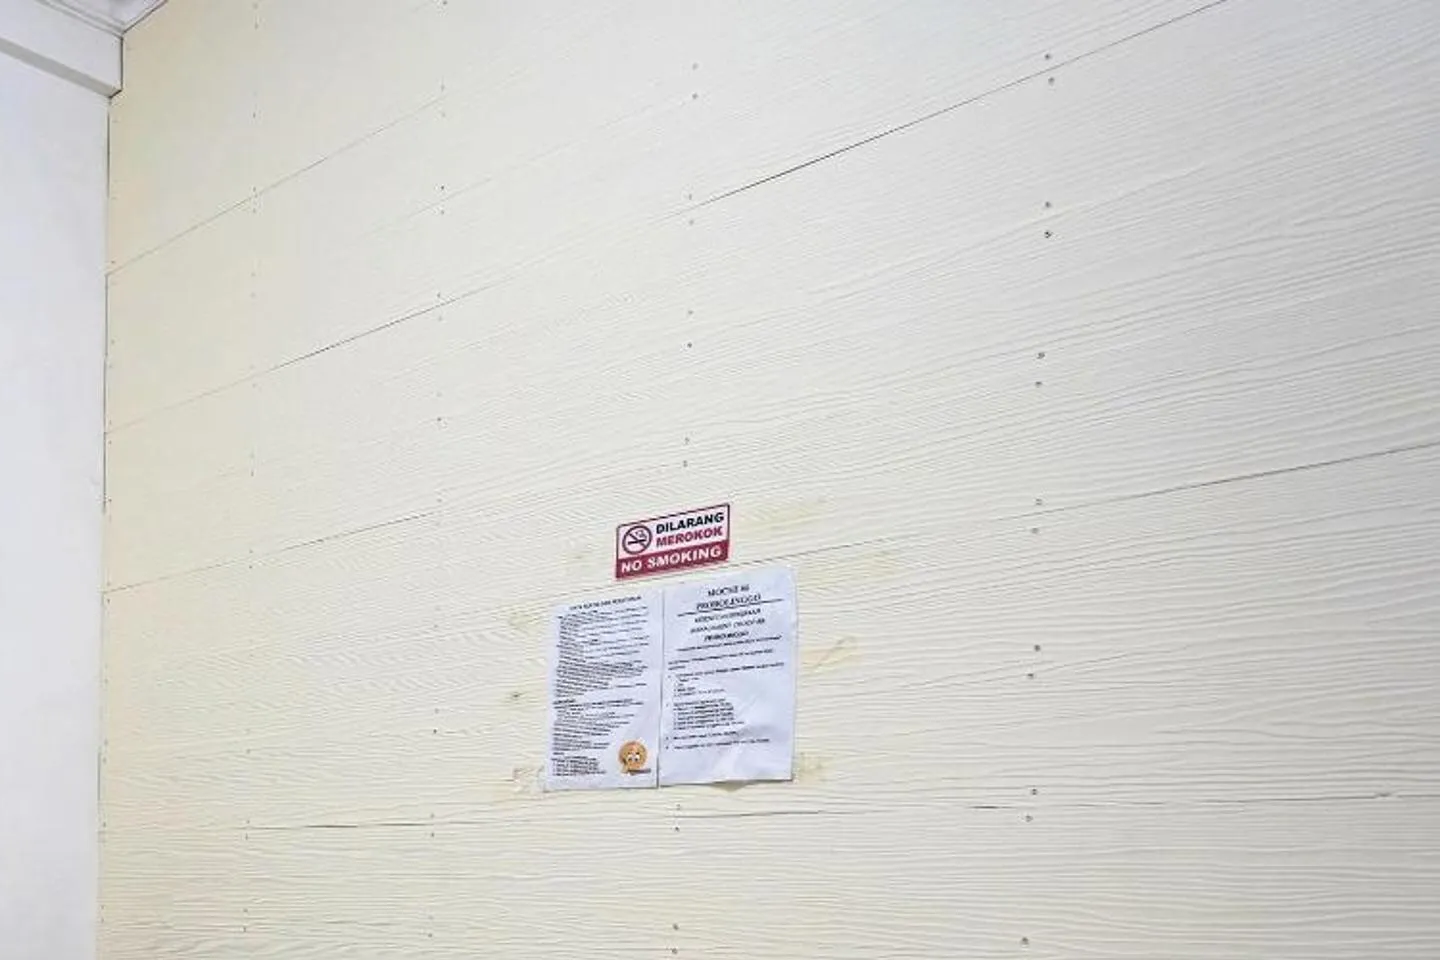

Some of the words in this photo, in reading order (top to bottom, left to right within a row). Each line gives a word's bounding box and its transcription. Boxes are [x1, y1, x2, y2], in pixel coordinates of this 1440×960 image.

[656, 512, 724, 534] DILARANG
[656, 526, 723, 547] MEROKOK
[621, 560, 642, 573] NO
[647, 545, 721, 569] SMOKING
